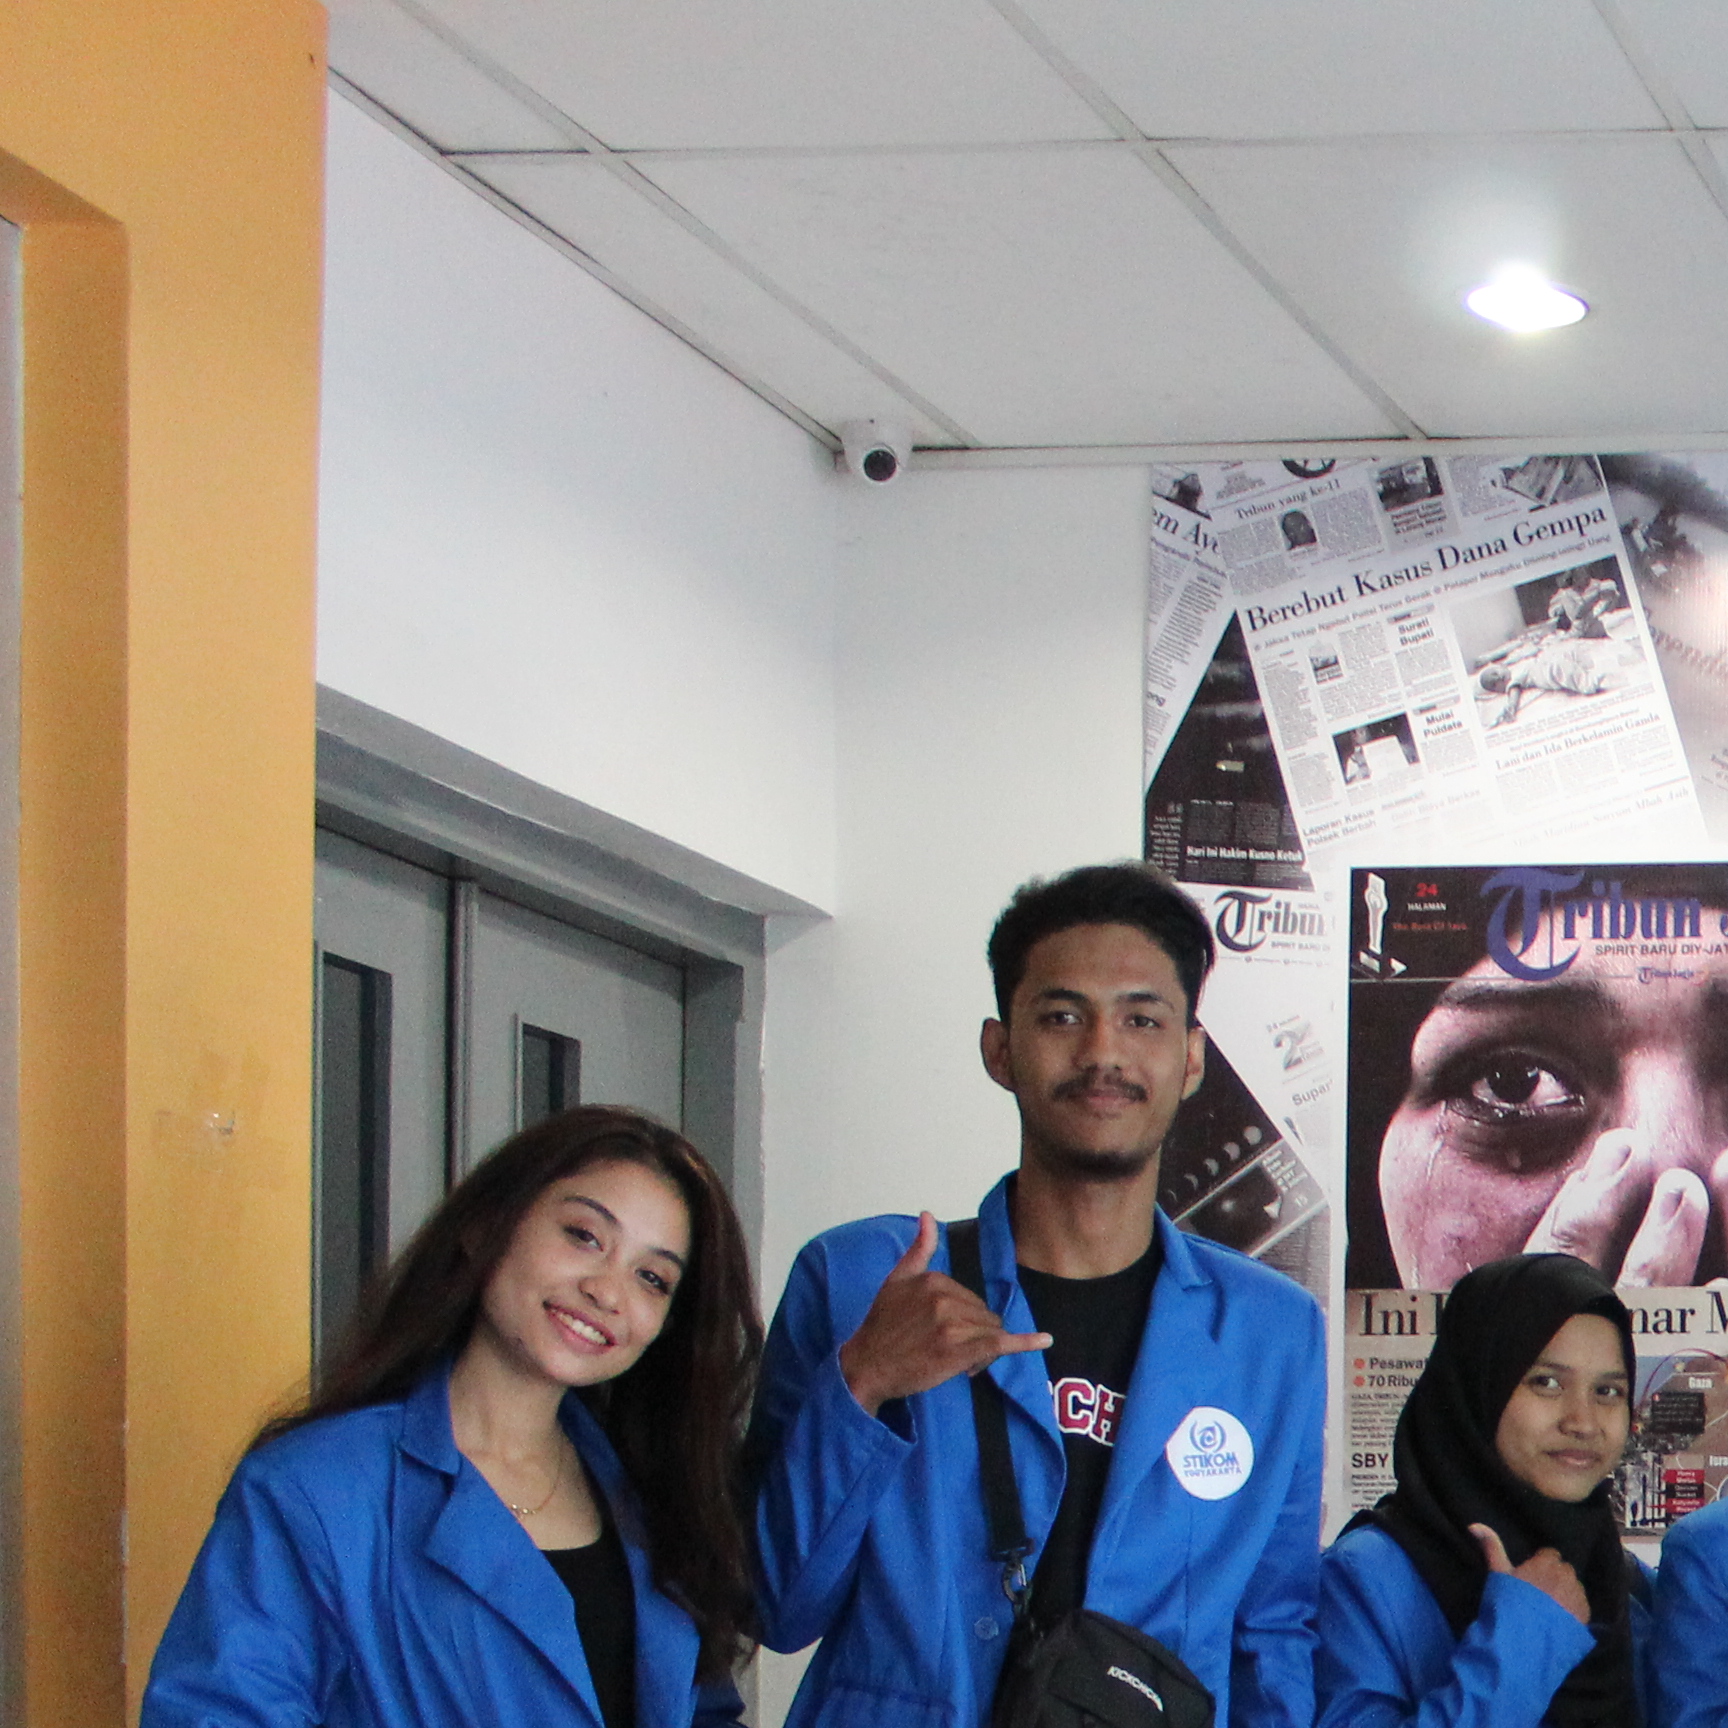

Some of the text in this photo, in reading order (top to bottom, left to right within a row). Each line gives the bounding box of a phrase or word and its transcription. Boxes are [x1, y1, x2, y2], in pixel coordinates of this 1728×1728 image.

[1246, 504, 1609, 633] Berebut Kasus Dana Gempa
[1521, 748, 1542, 764] dan
[1543, 742, 1562, 758] Ida
[1624, 713, 1661, 733] Ganda
[1416, 882, 1439, 897] 24
[1407, 902, 1448, 912] HALAMAN
[1479, 866, 1704, 983] Tribun
[1594, 943, 1638, 957] SPIRIT
[1640, 943, 1678, 957] BARU
[1358, 1290, 1422, 1337] Ini
[1368, 1374, 1387, 1388] 70
[1688, 1376, 1713, 1389] Gaza
[1047, 1376, 1127, 1447] CH
[1183, 1451, 1240, 1470] STIKOM
[1351, 1452, 1389, 1469] SBY
[1183, 1465, 1243, 1478] YOGYAKARTA
